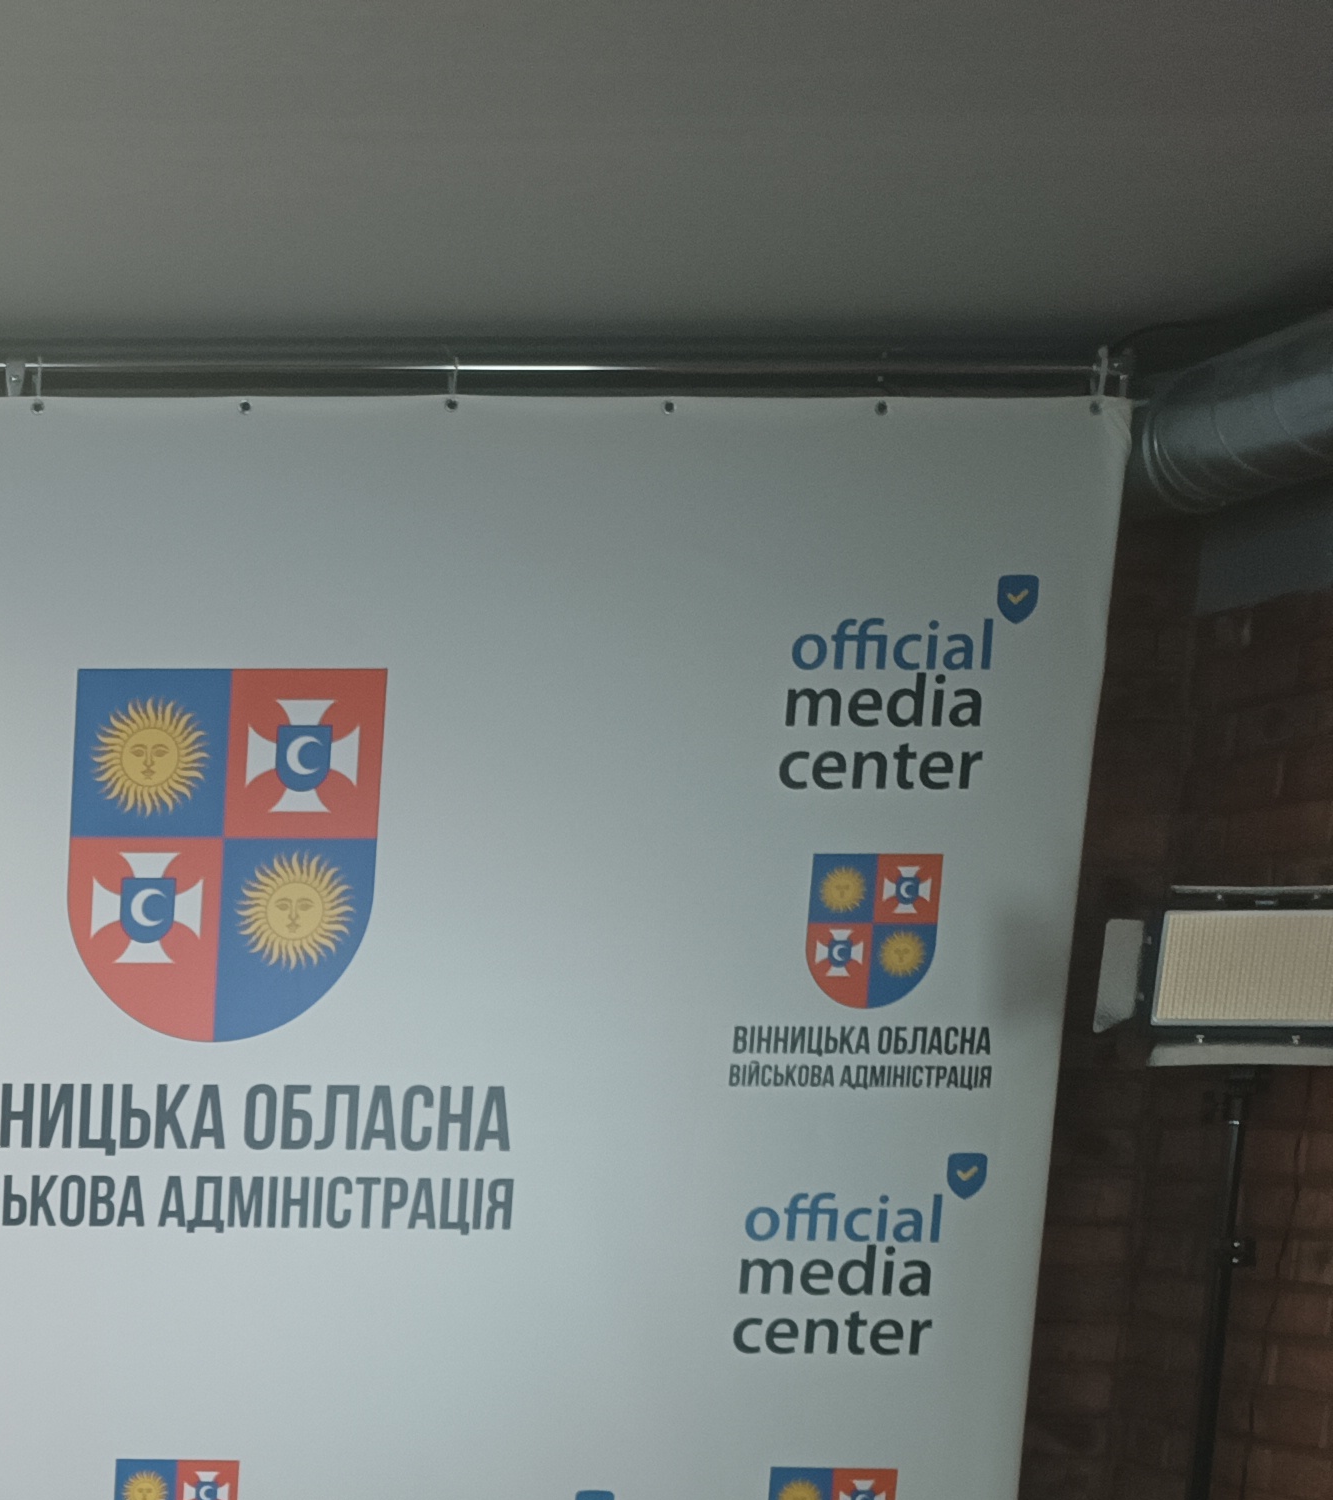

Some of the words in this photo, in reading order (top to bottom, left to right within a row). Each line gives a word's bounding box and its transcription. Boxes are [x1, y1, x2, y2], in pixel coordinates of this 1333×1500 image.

[792, 618, 993, 670] official
[785, 672, 982, 727] media
[779, 743, 983, 790] center
[733, 1026, 870, 1057] ВІННИЦЬКА
[878, 1026, 990, 1055] ОБЛАСНА
[729, 1061, 834, 1087] ВІЙСЬКОВА
[840, 1065, 992, 1091] АДМІНІСТРАЦІЯ
[244, 1084, 510, 1151] ОБЛАСНА
[158, 1175, 514, 1235] АДМІНІСТРАЦІЯ
[745, 1192, 943, 1243] official
[739, 1244, 931, 1297] media
[733, 1311, 932, 1355] center
